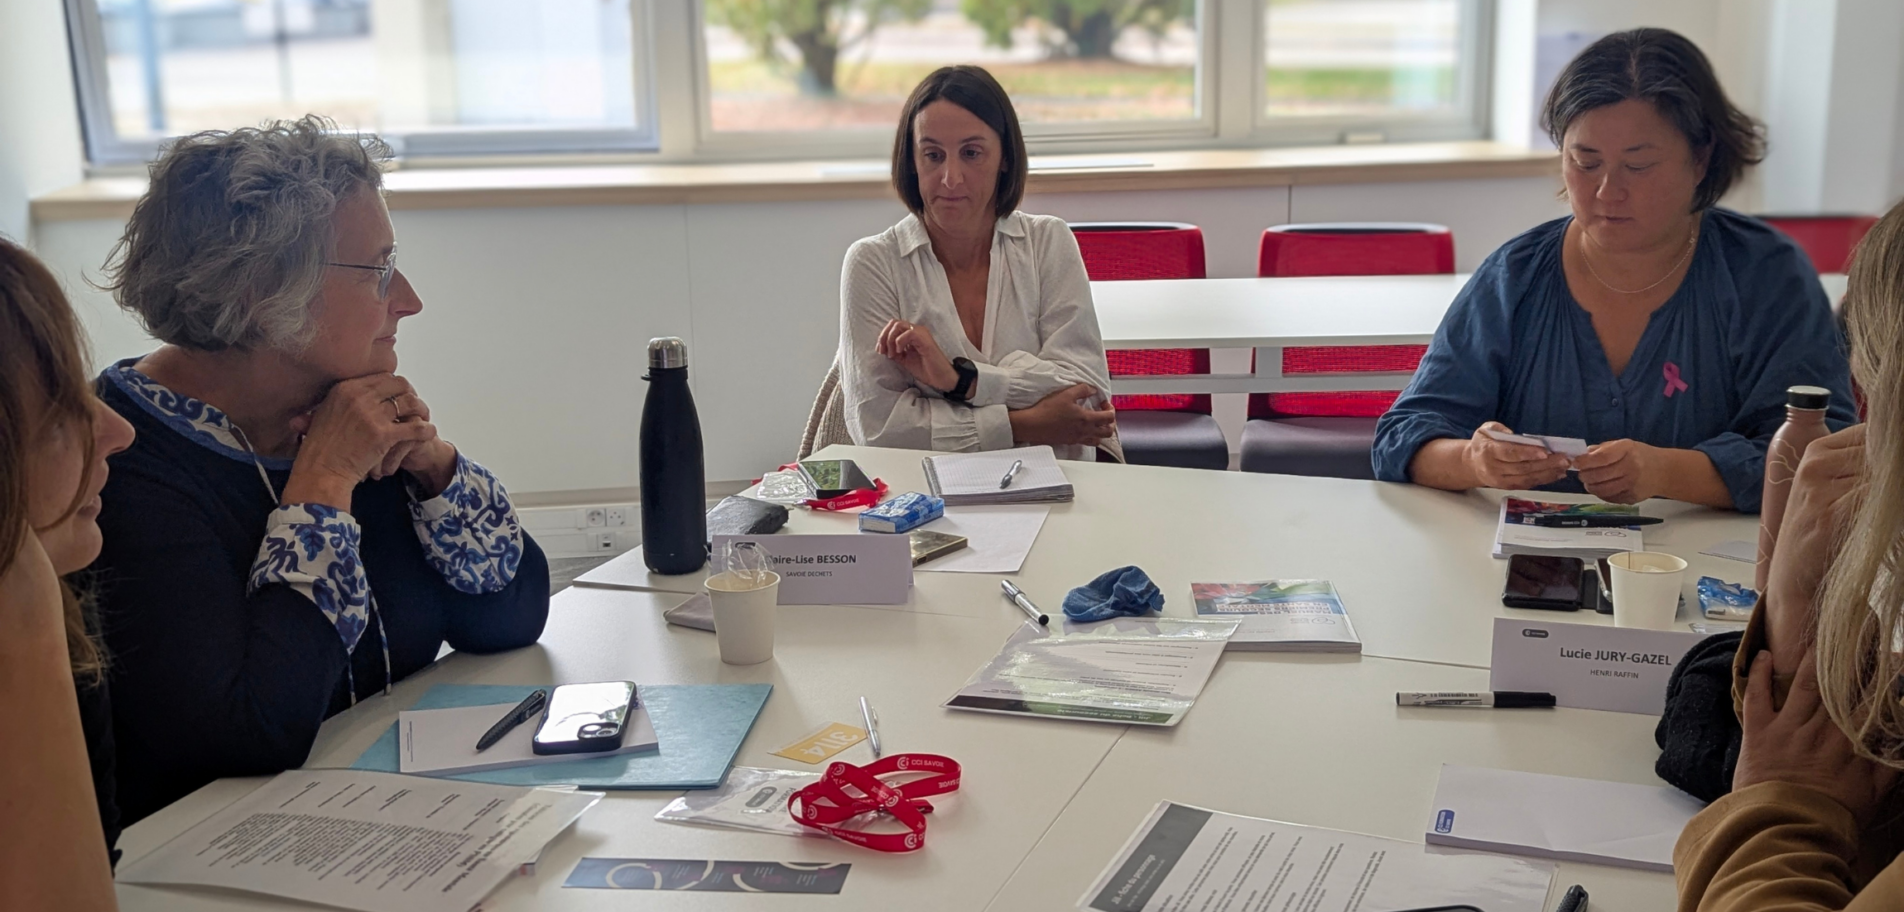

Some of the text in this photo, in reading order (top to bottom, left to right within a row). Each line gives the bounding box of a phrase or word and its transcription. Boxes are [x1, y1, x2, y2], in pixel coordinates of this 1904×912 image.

[816, 554, 857, 564] BESSON
[1560, 647, 1672, 665] Lucie JURY-GAZEL
[1590, 669, 1639, 679] HENRI RAFFIN
[801, 731, 859, 757] 3114
[923, 760, 944, 768] SAVOIE
